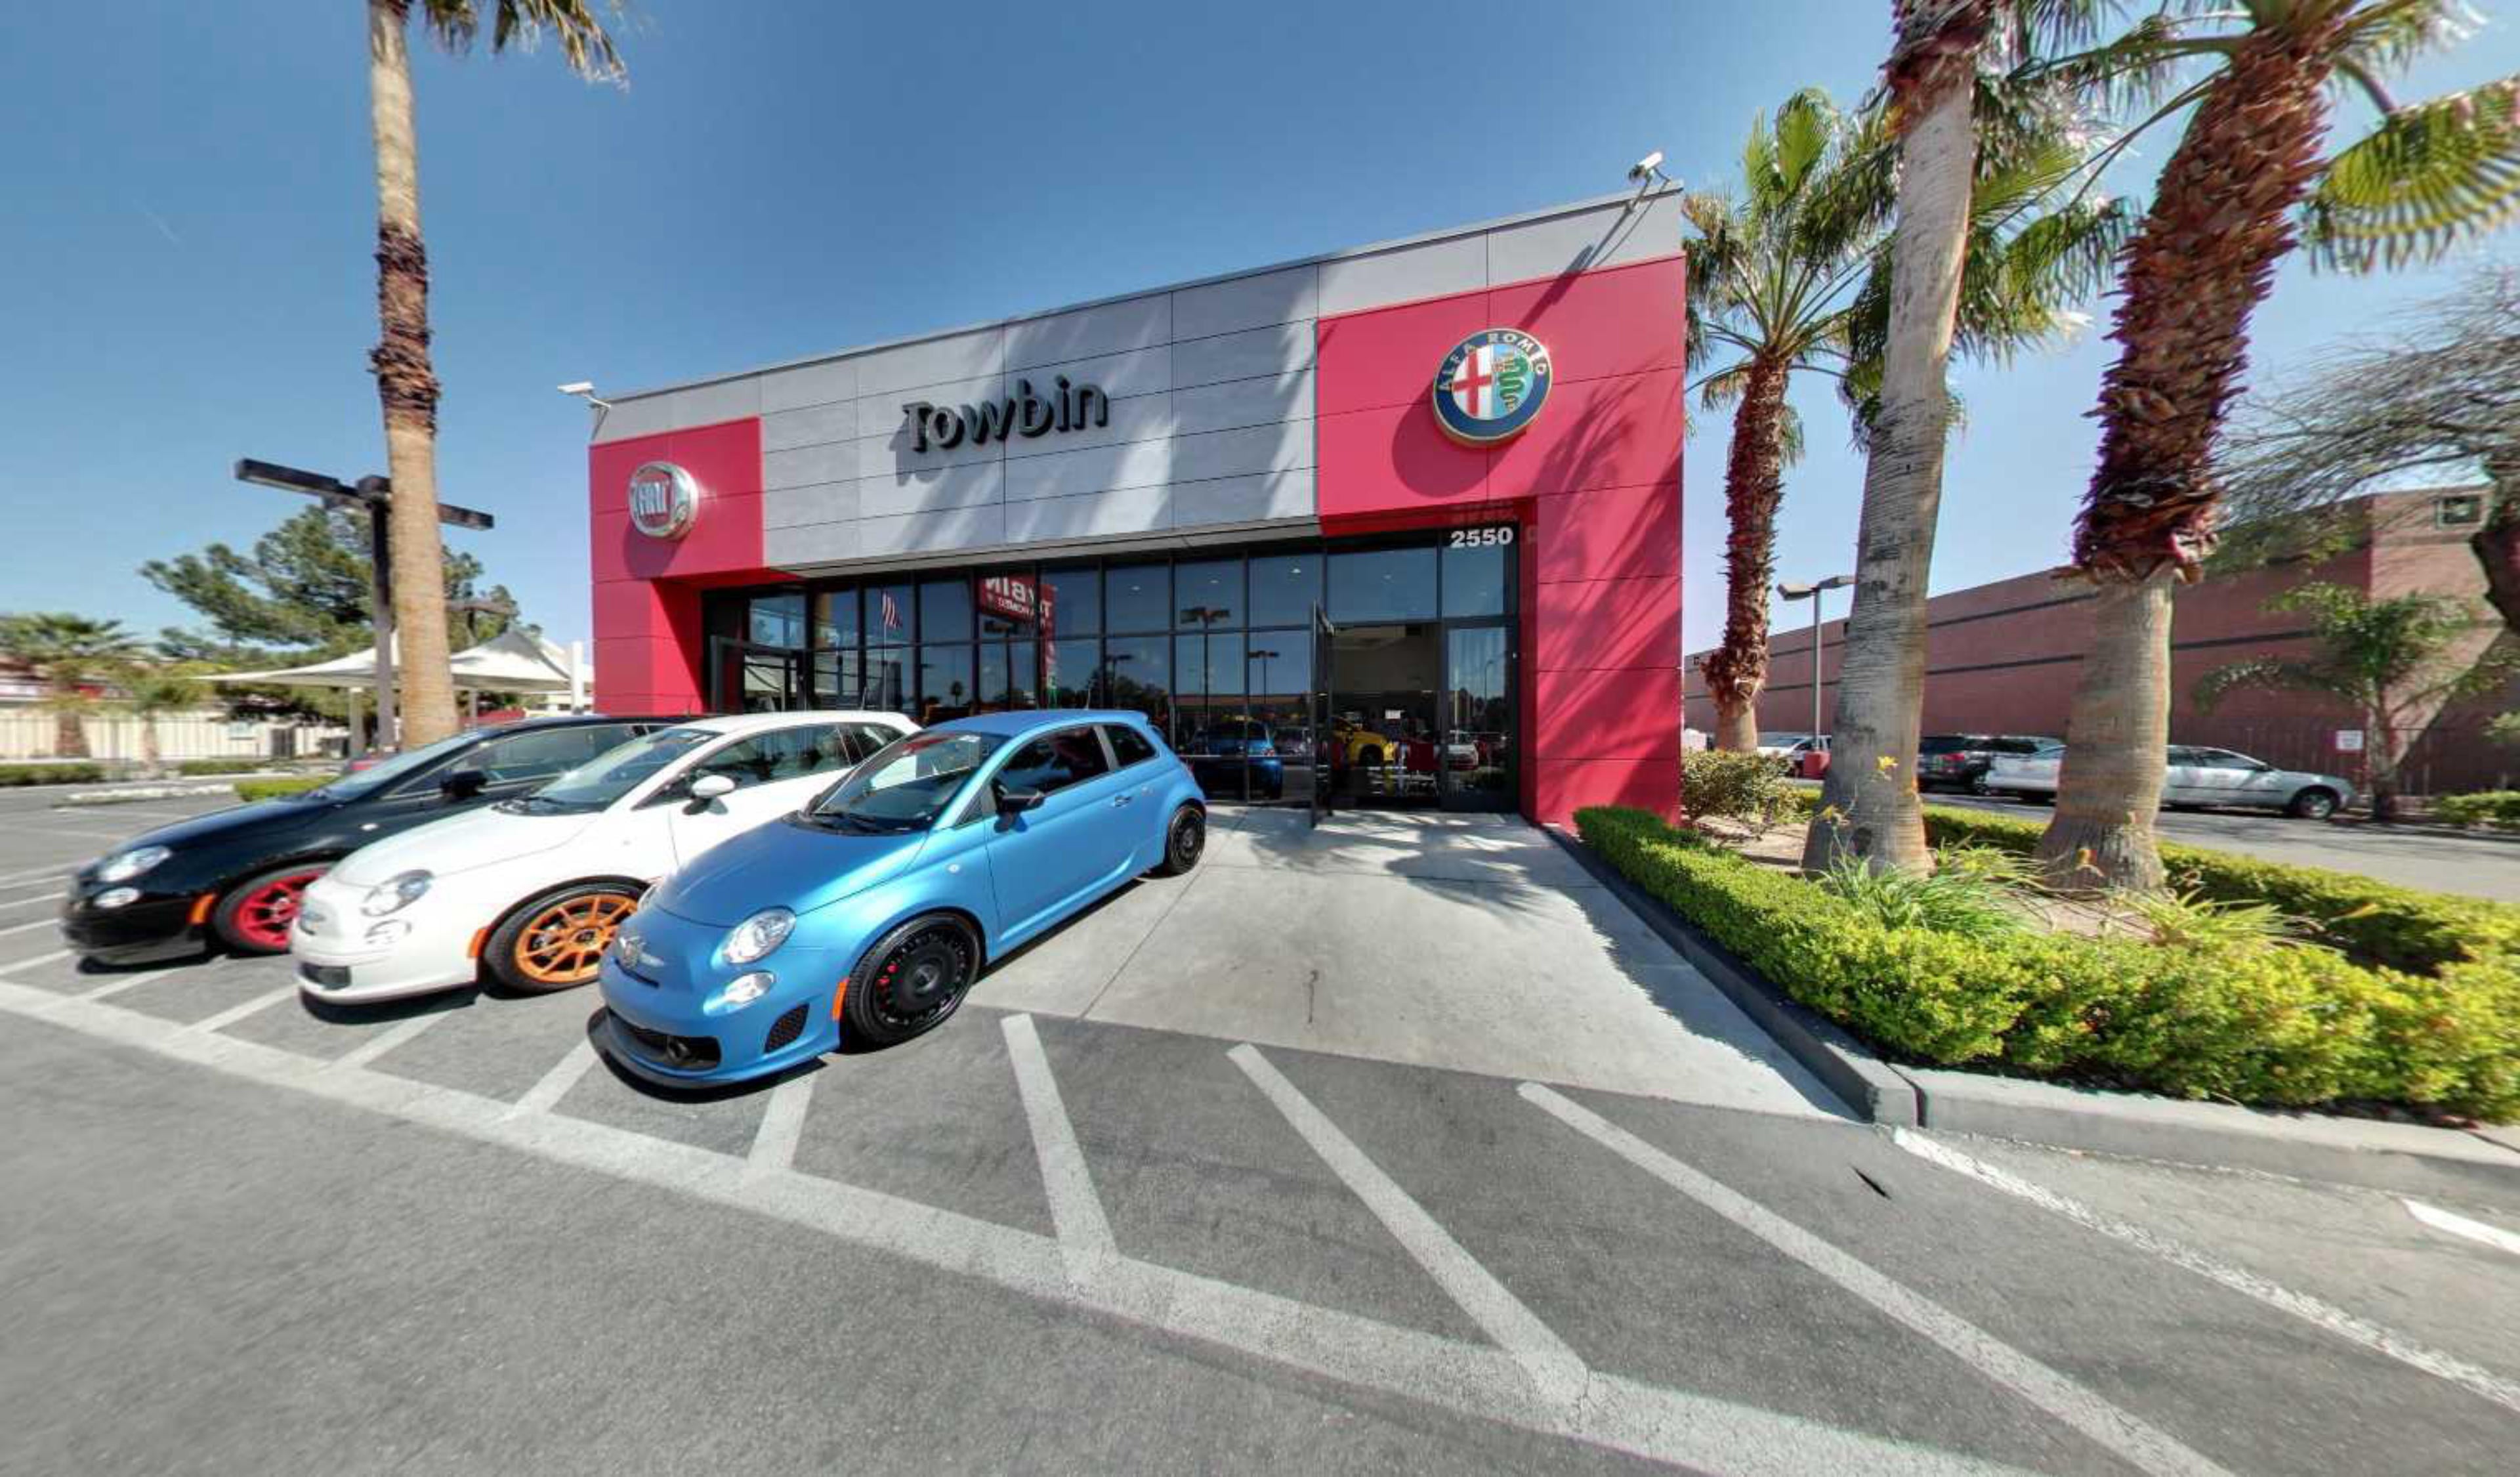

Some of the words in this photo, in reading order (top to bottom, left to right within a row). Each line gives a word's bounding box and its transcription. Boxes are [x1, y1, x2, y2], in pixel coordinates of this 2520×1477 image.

[1438, 343, 1479, 391] ALFA
[1488, 333, 1547, 375] ROMEO
[902, 374, 1108, 452] Towbin
[1450, 526, 1513, 548] 2550
